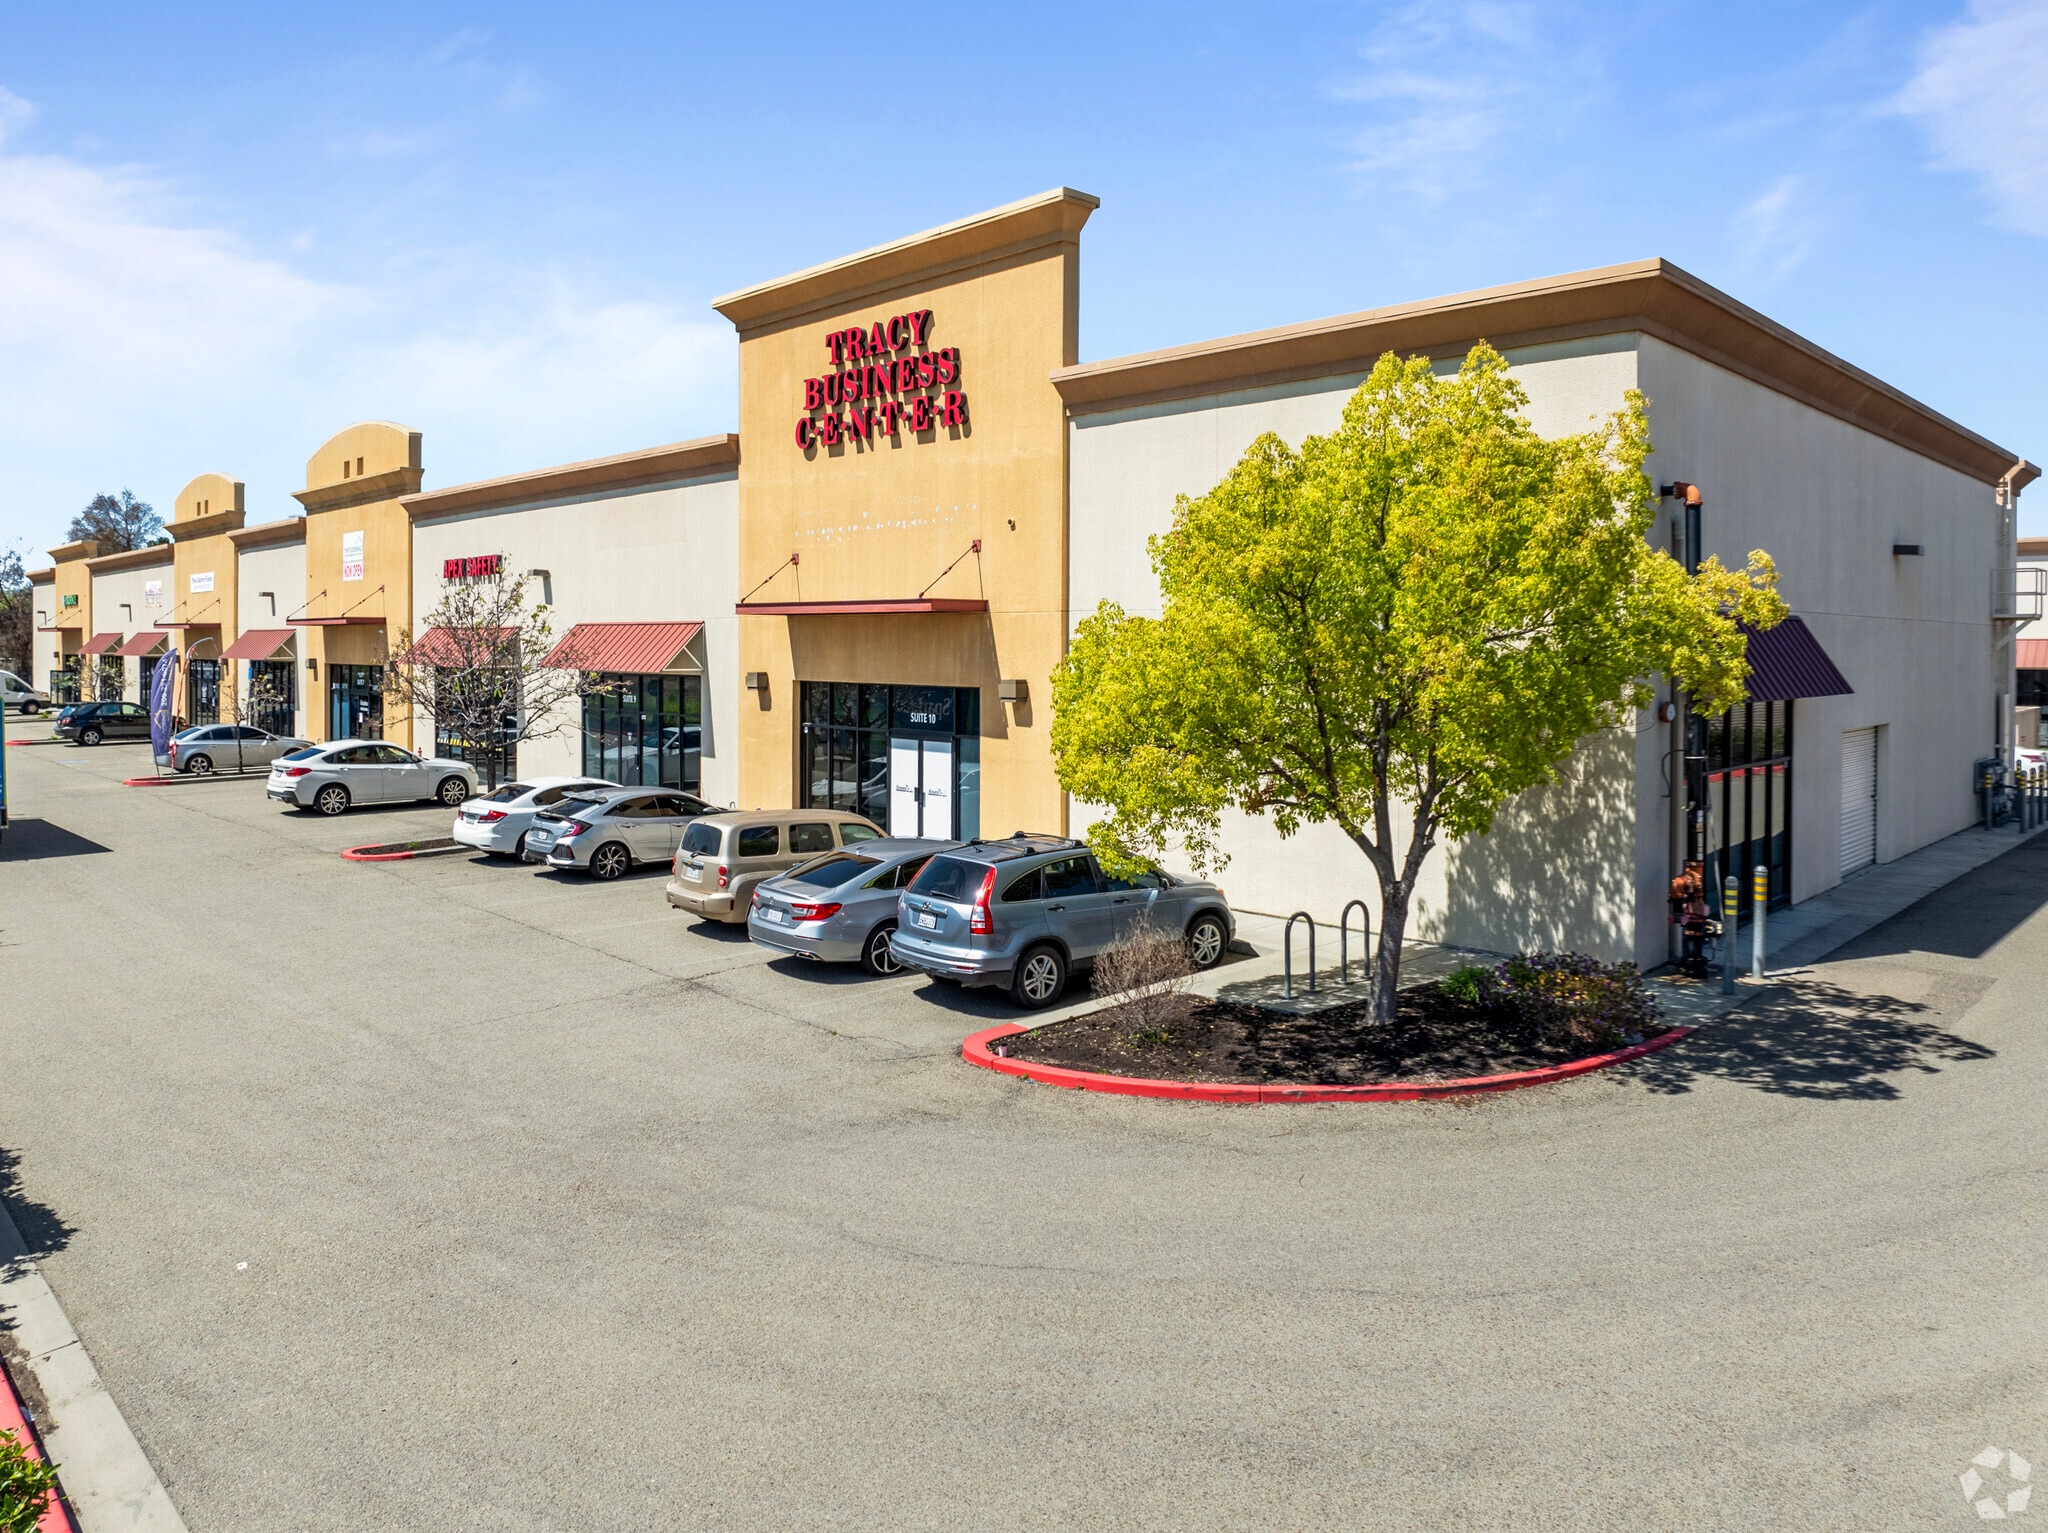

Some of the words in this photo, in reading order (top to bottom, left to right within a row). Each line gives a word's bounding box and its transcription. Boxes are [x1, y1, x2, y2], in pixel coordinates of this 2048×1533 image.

[826, 309, 931, 365] TRACY
[804, 347, 957, 410] BUSINESS
[443, 558, 464, 578] APEX
[466, 555, 498, 577] SAFETY
[910, 712, 927, 723] SUITE
[928, 714, 936, 724] 10
